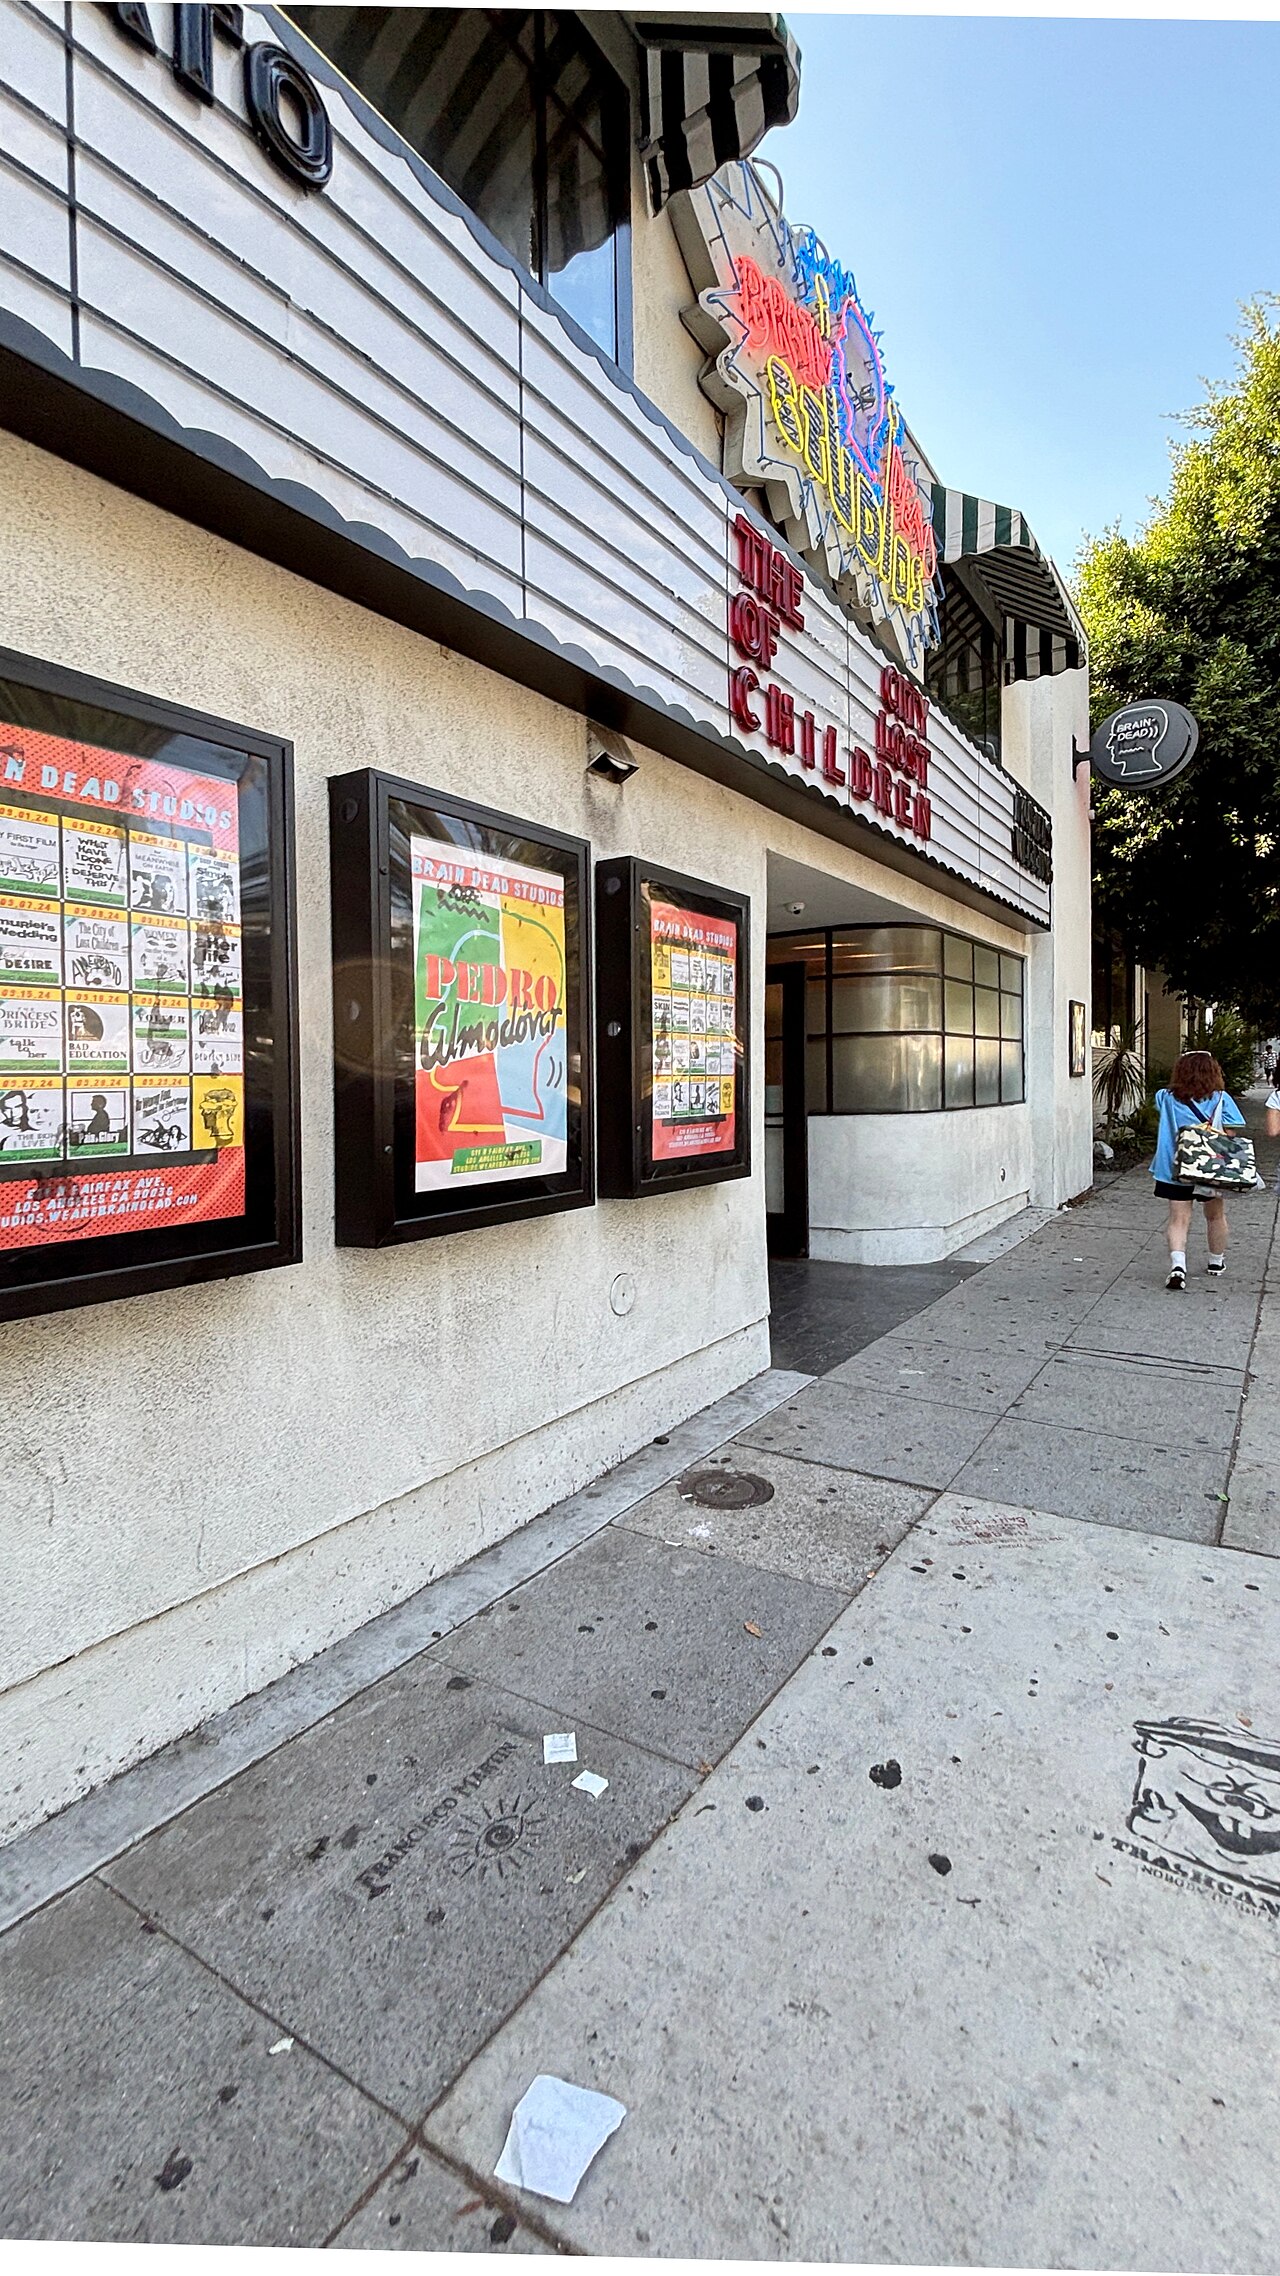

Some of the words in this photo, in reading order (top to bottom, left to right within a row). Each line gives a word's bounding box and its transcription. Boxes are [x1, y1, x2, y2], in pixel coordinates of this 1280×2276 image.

[737, 255, 833, 391] BRAIN
[767, 355, 925, 613] STUDIOS
[734, 513, 805, 632] THE
[880, 664, 929, 740] CITY
[729, 590, 781, 671] OF
[875, 709, 931, 789] LOST
[1117, 728, 1149, 741] DEAD
[728, 665, 932, 842] CHILDREN
[41, 765, 120, 803] DEAD
[132, 788, 232, 829] STUDIOS
[7, 832, 34, 843] FIRST
[36, 837, 56, 847] FILM
[77, 837, 109, 849] WHAT
[77, 845, 107, 857] HAVE
[81, 854, 112, 865] DONE
[87, 863, 102, 872] TO
[72, 868, 119, 882] DESERVE
[412, 855, 465, 884] BRAIN
[471, 870, 509, 894] DEAD
[513, 883, 564, 907] STUDIOS
[78, 922, 91, 935] The
[92, 922, 106, 938] City
[654, 920, 680, 933] BRAIN
[682, 926, 704, 940] DEAD
[706, 931, 734, 947] STUDIOS
[5, 959, 53, 969] DESIRE
[425, 954, 557, 1012] PEDRO
[4, 1019, 47, 1029] BRIDE
[9, 1039, 35, 1047] talk
[18, 1044, 29, 1052] to
[69, 1043, 89, 1051] BAD
[27, 1050, 47, 1058] her
[69, 1051, 127, 1059] EDUCATION
[71, 1179, 132, 1196] FAIRFAX
[136, 1176, 165, 1188] AVE.
[14, 1200, 41, 1213] LOS
[46, 1192, 106, 1210] ANGELES
[111, 1191, 129, 1202] CA
[133, 1186, 174, 1199] 90036
